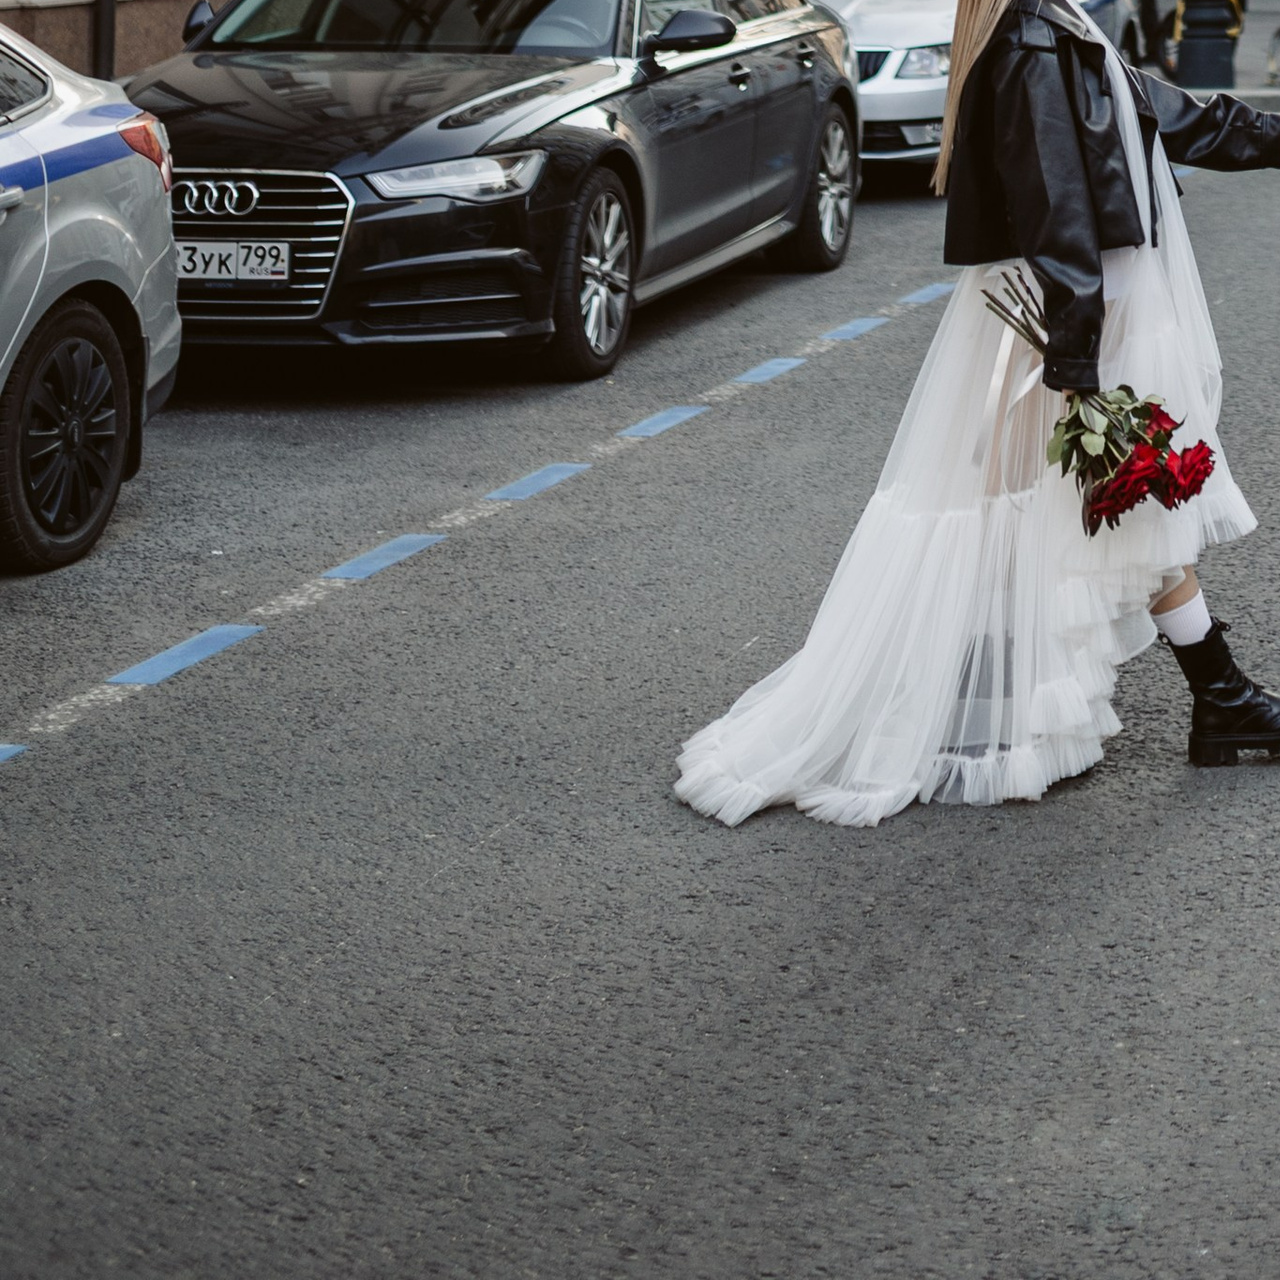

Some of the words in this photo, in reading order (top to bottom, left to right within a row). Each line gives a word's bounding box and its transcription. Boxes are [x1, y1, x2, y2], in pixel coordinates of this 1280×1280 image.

[177, 246, 233, 275] 3УК
[240, 245, 281, 267] 799
[248, 267, 270, 275] RUS
